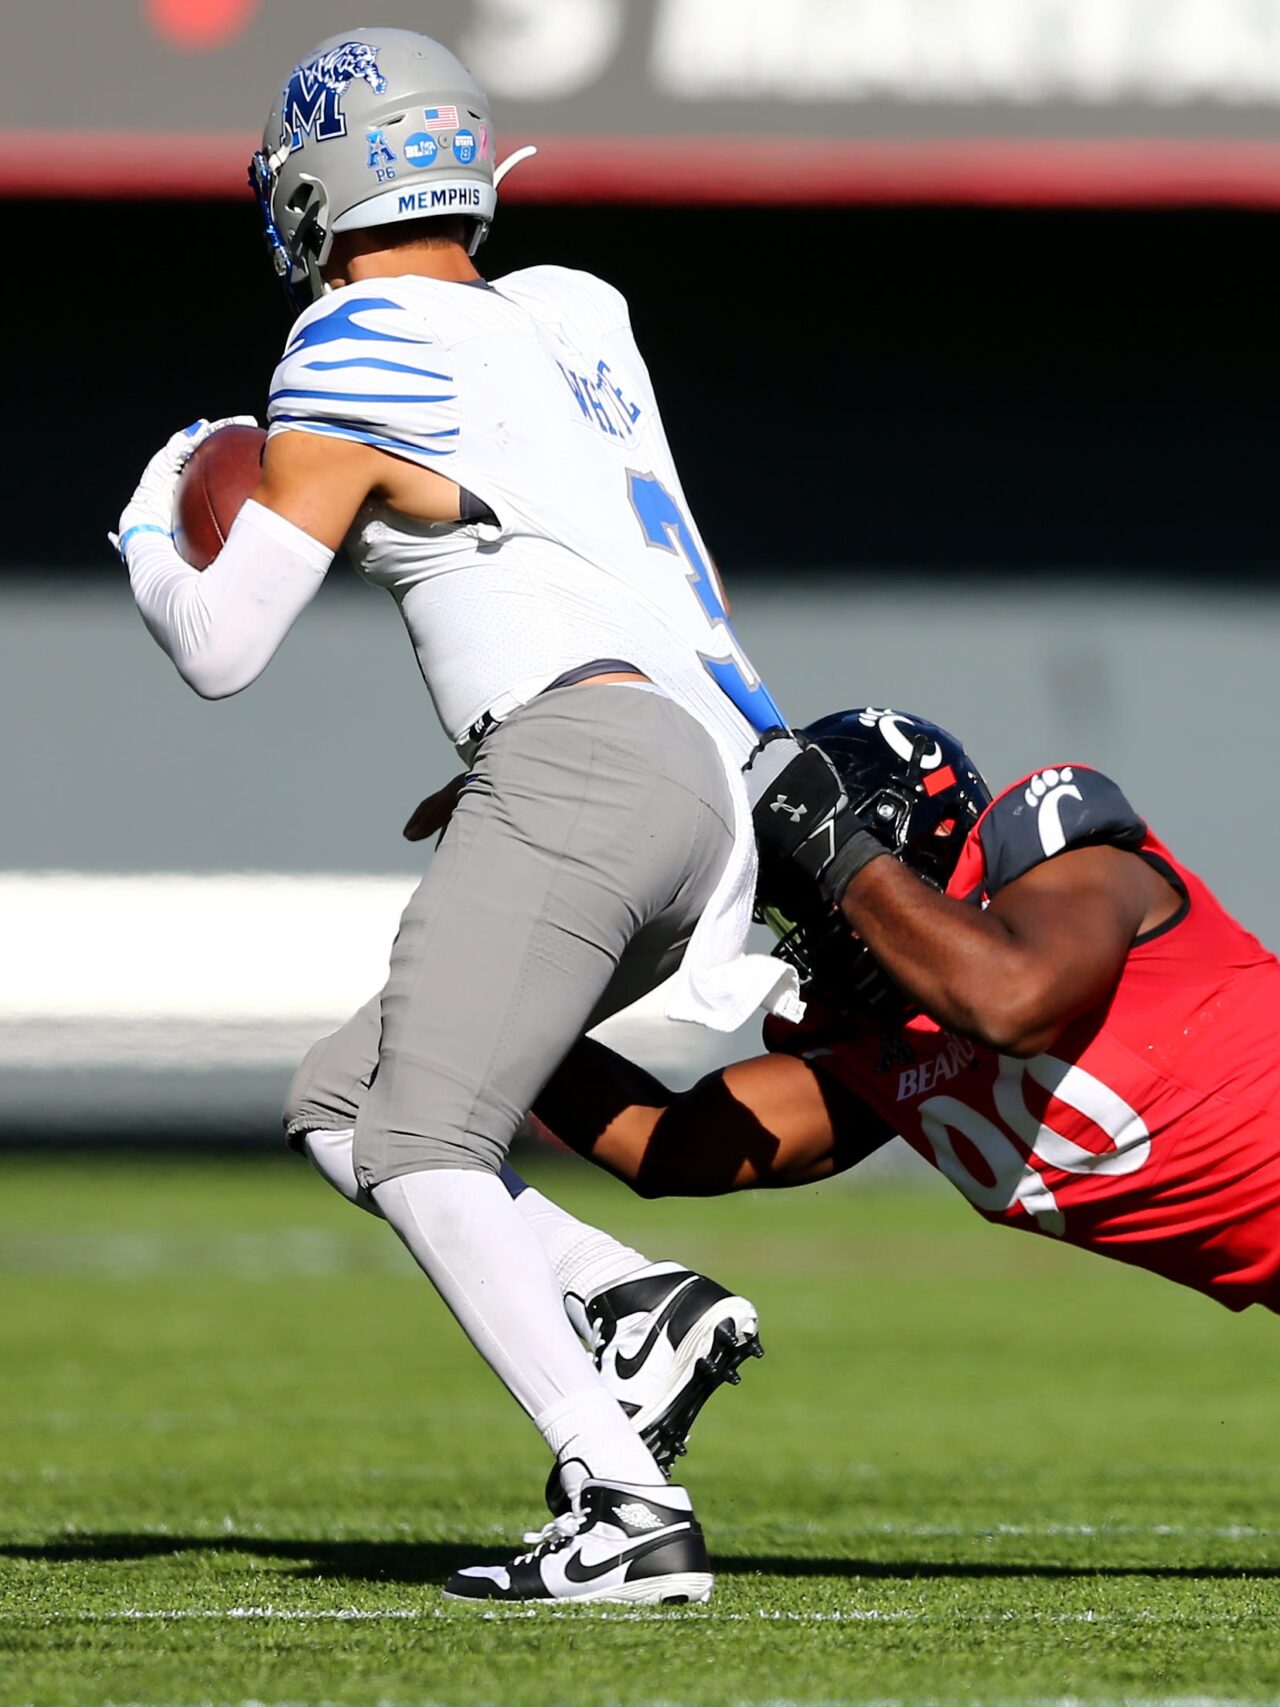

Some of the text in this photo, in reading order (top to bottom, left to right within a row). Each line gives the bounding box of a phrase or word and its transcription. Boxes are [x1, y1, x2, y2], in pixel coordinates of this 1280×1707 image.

[376, 166, 396, 182] P6
[398, 188, 481, 214] MEMPHIS
[624, 466, 788, 735] 3
